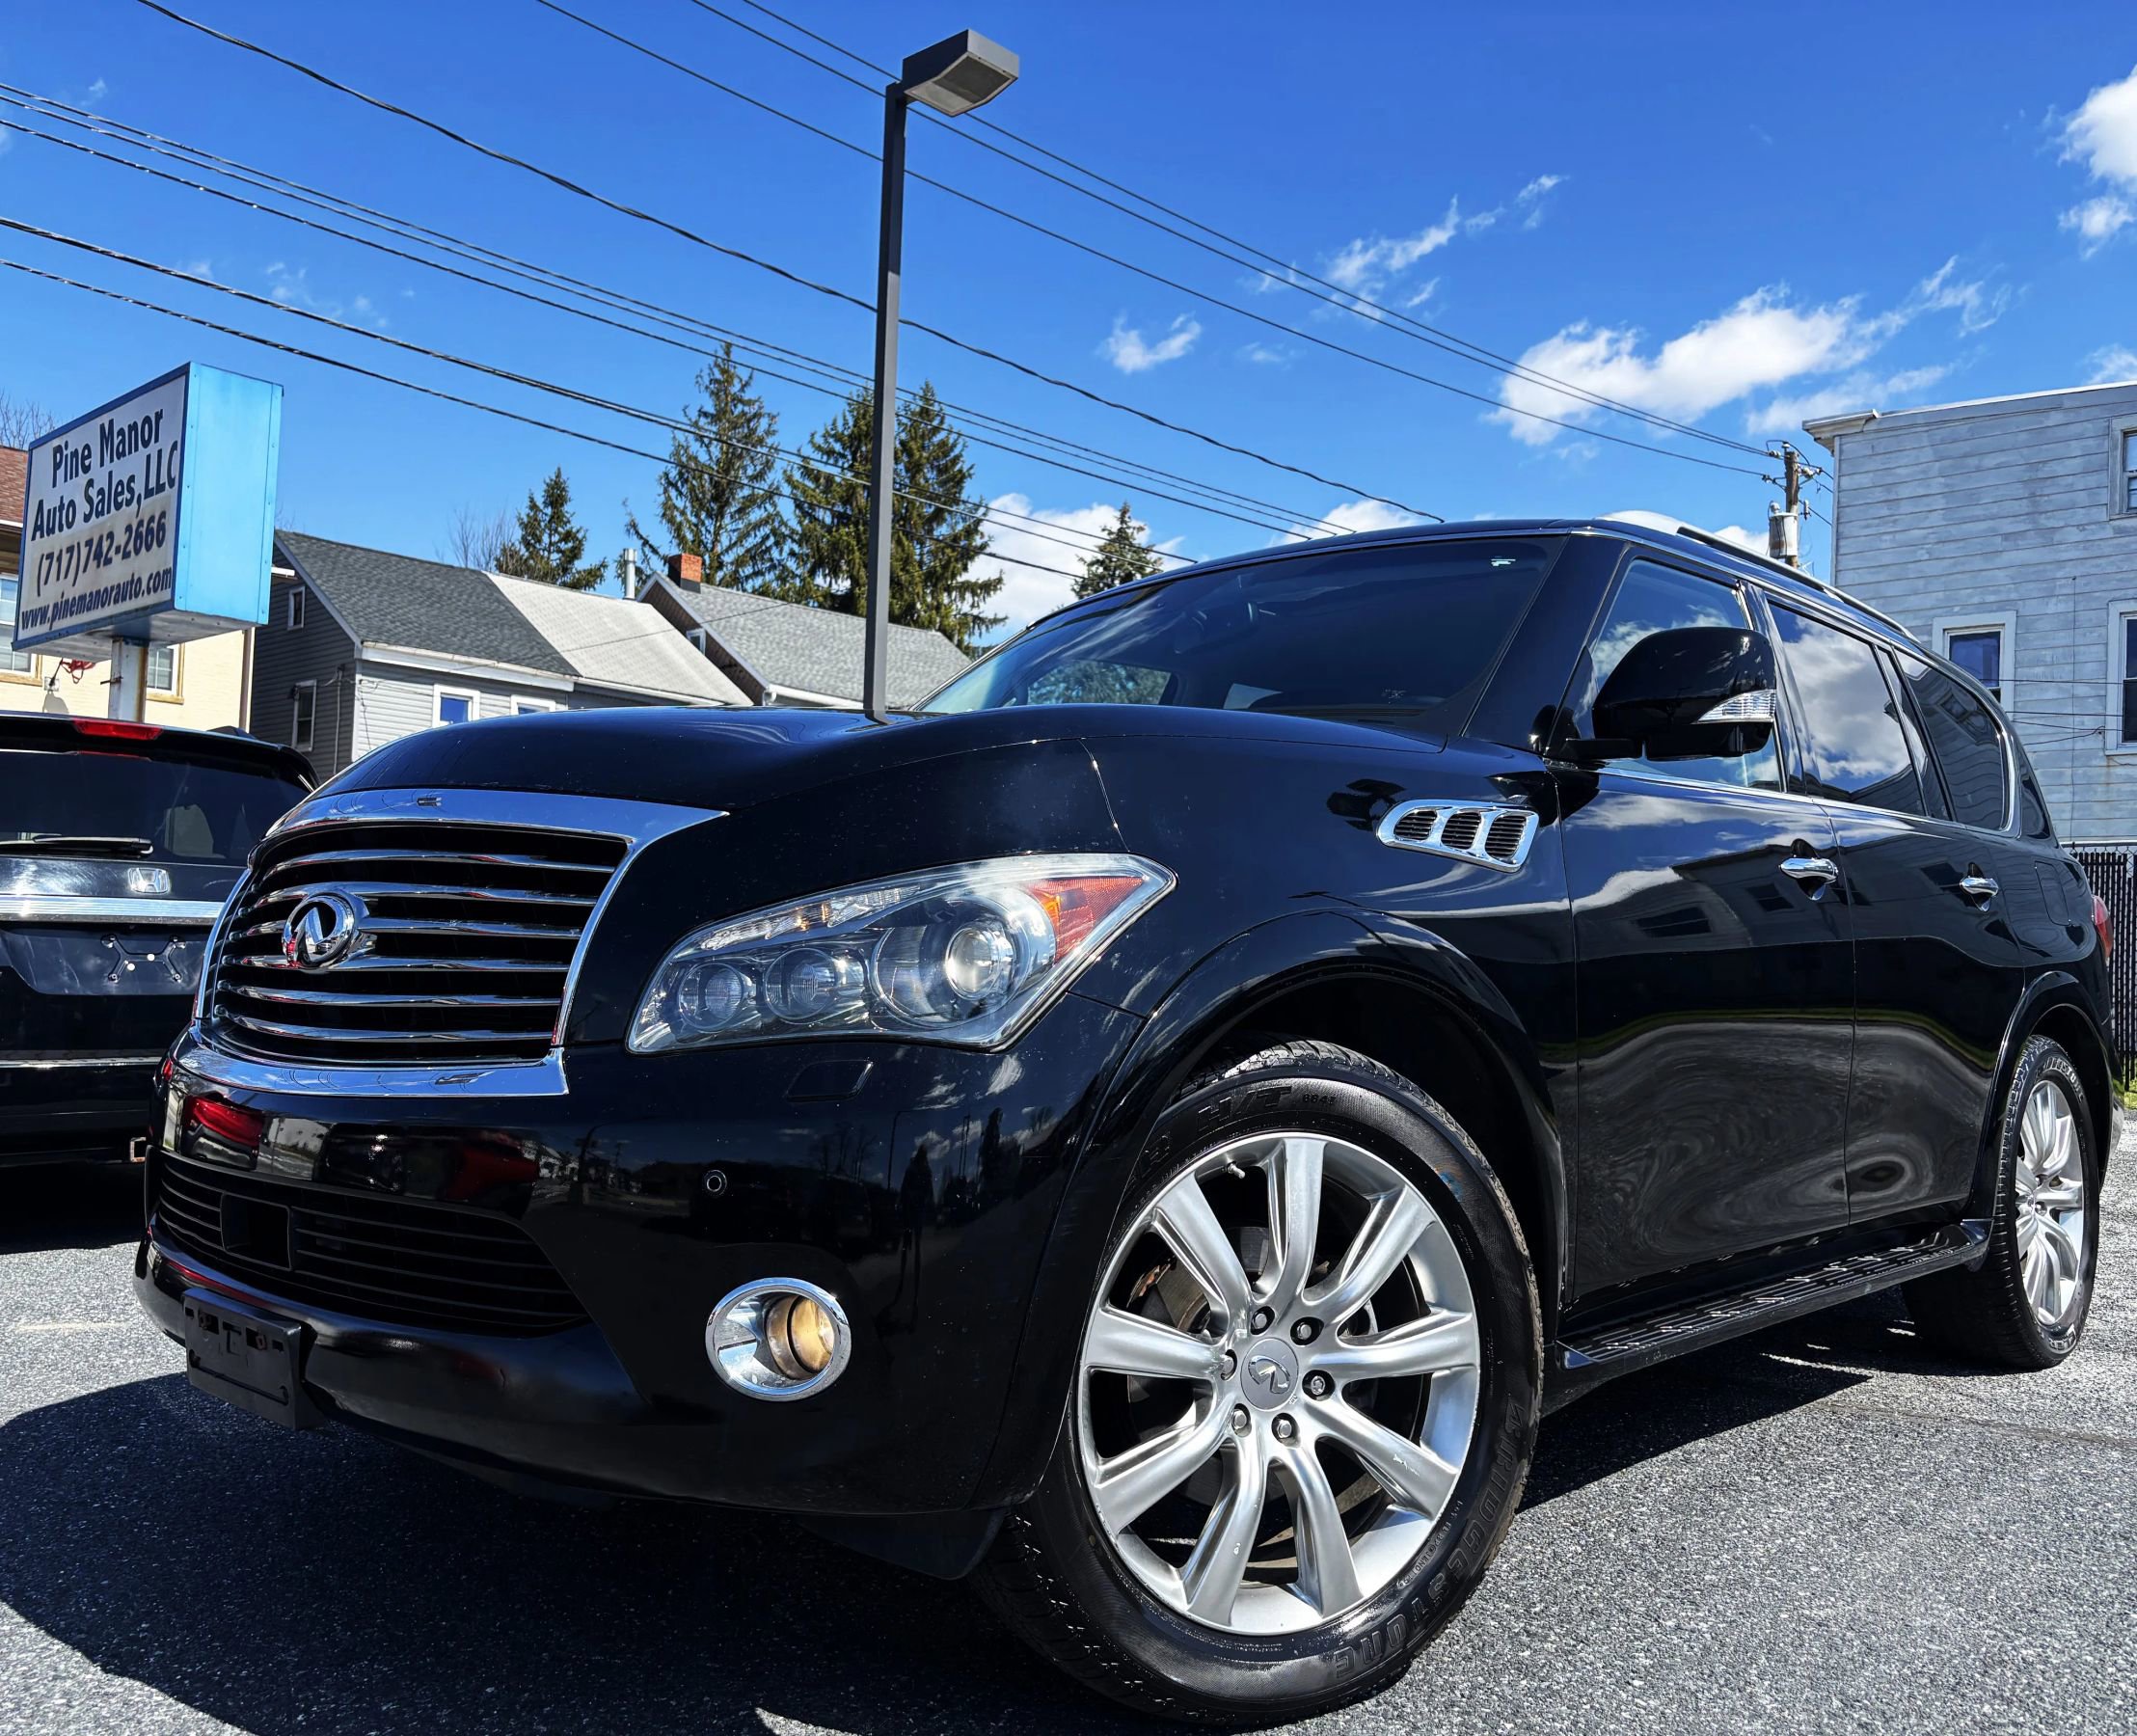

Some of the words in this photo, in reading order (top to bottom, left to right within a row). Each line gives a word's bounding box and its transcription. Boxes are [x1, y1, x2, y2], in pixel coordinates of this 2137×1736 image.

[52, 441, 93, 488] Pine
[99, 409, 164, 468] Manor
[31, 494, 77, 542] Auto
[21, 565, 173, 631] www.pinemanorauto.com
